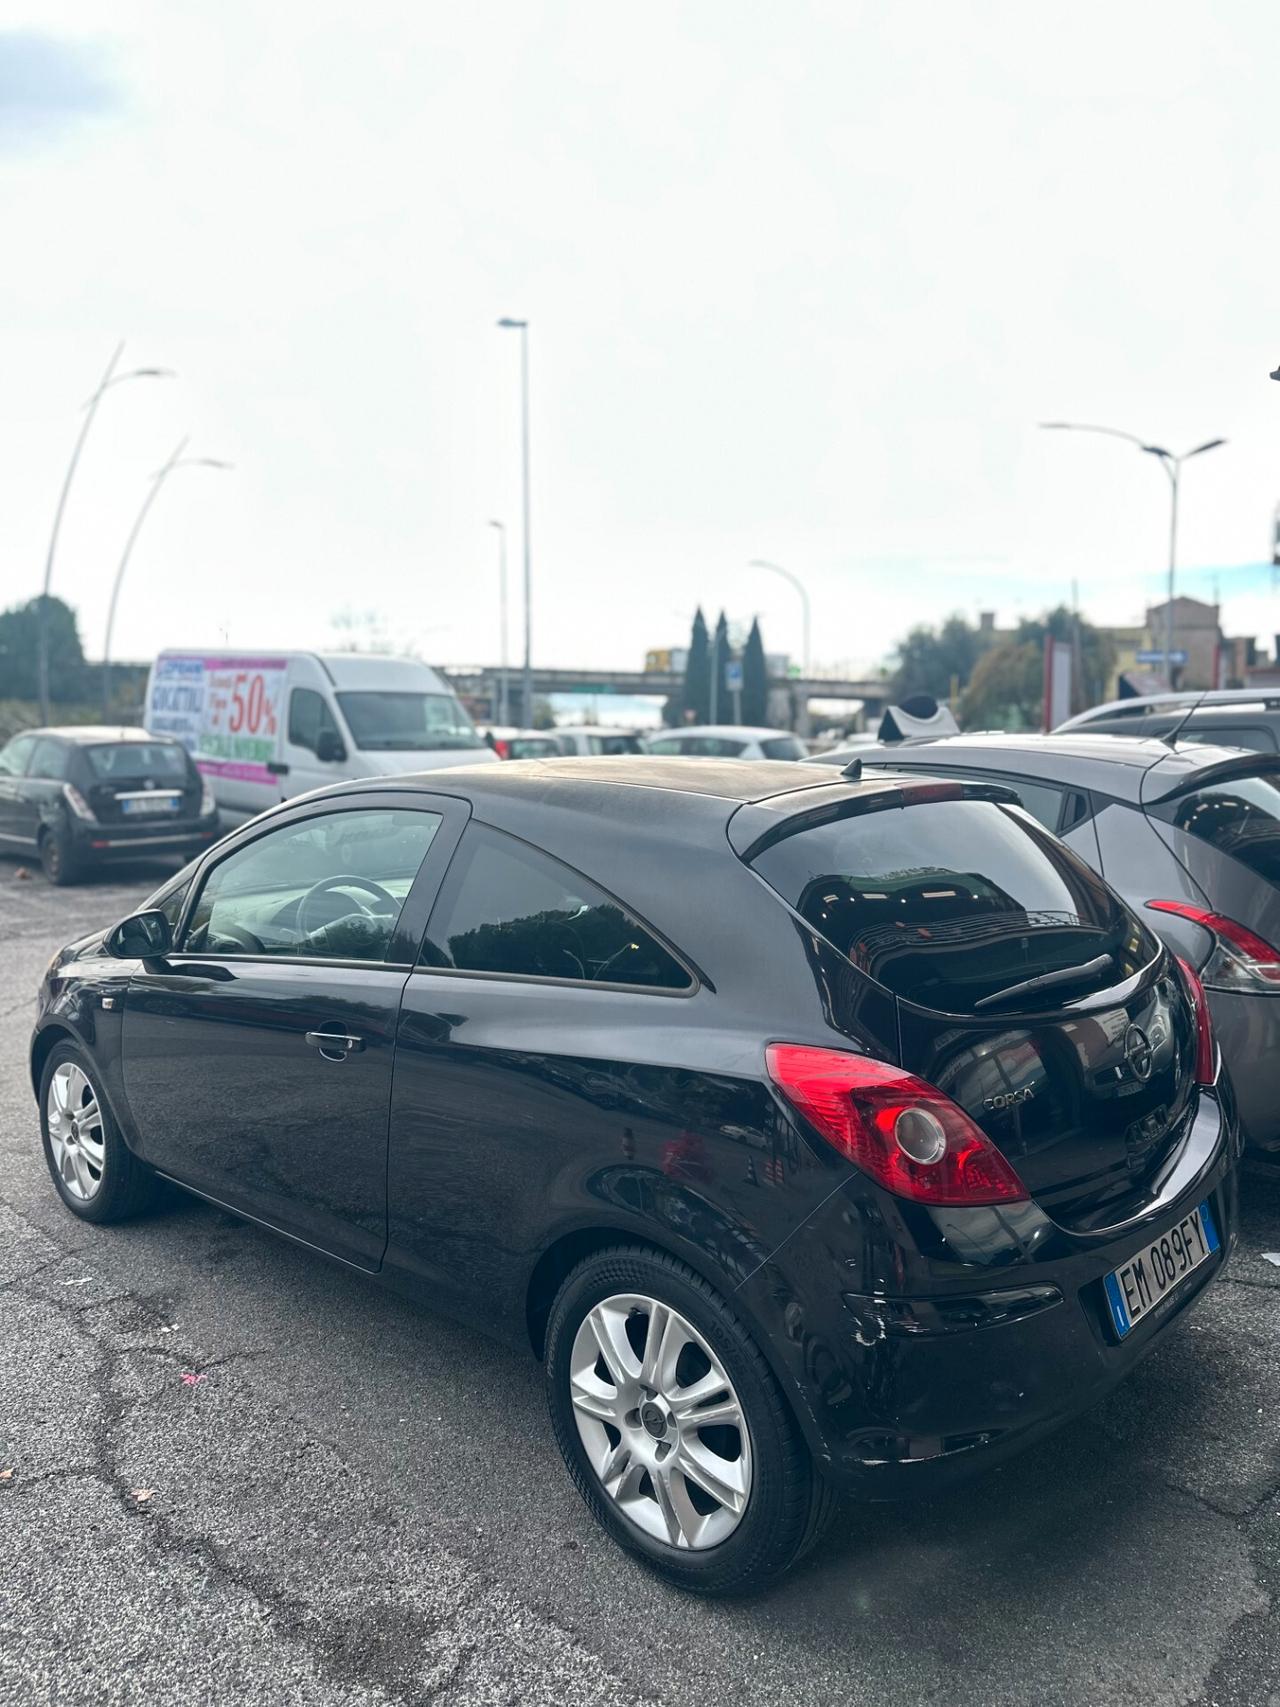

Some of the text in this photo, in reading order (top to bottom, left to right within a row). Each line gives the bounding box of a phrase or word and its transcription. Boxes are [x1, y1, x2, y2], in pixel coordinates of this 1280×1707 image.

[983, 1087, 1035, 1110] CORSA
[1120, 1211, 1206, 1318] EM 089FY
